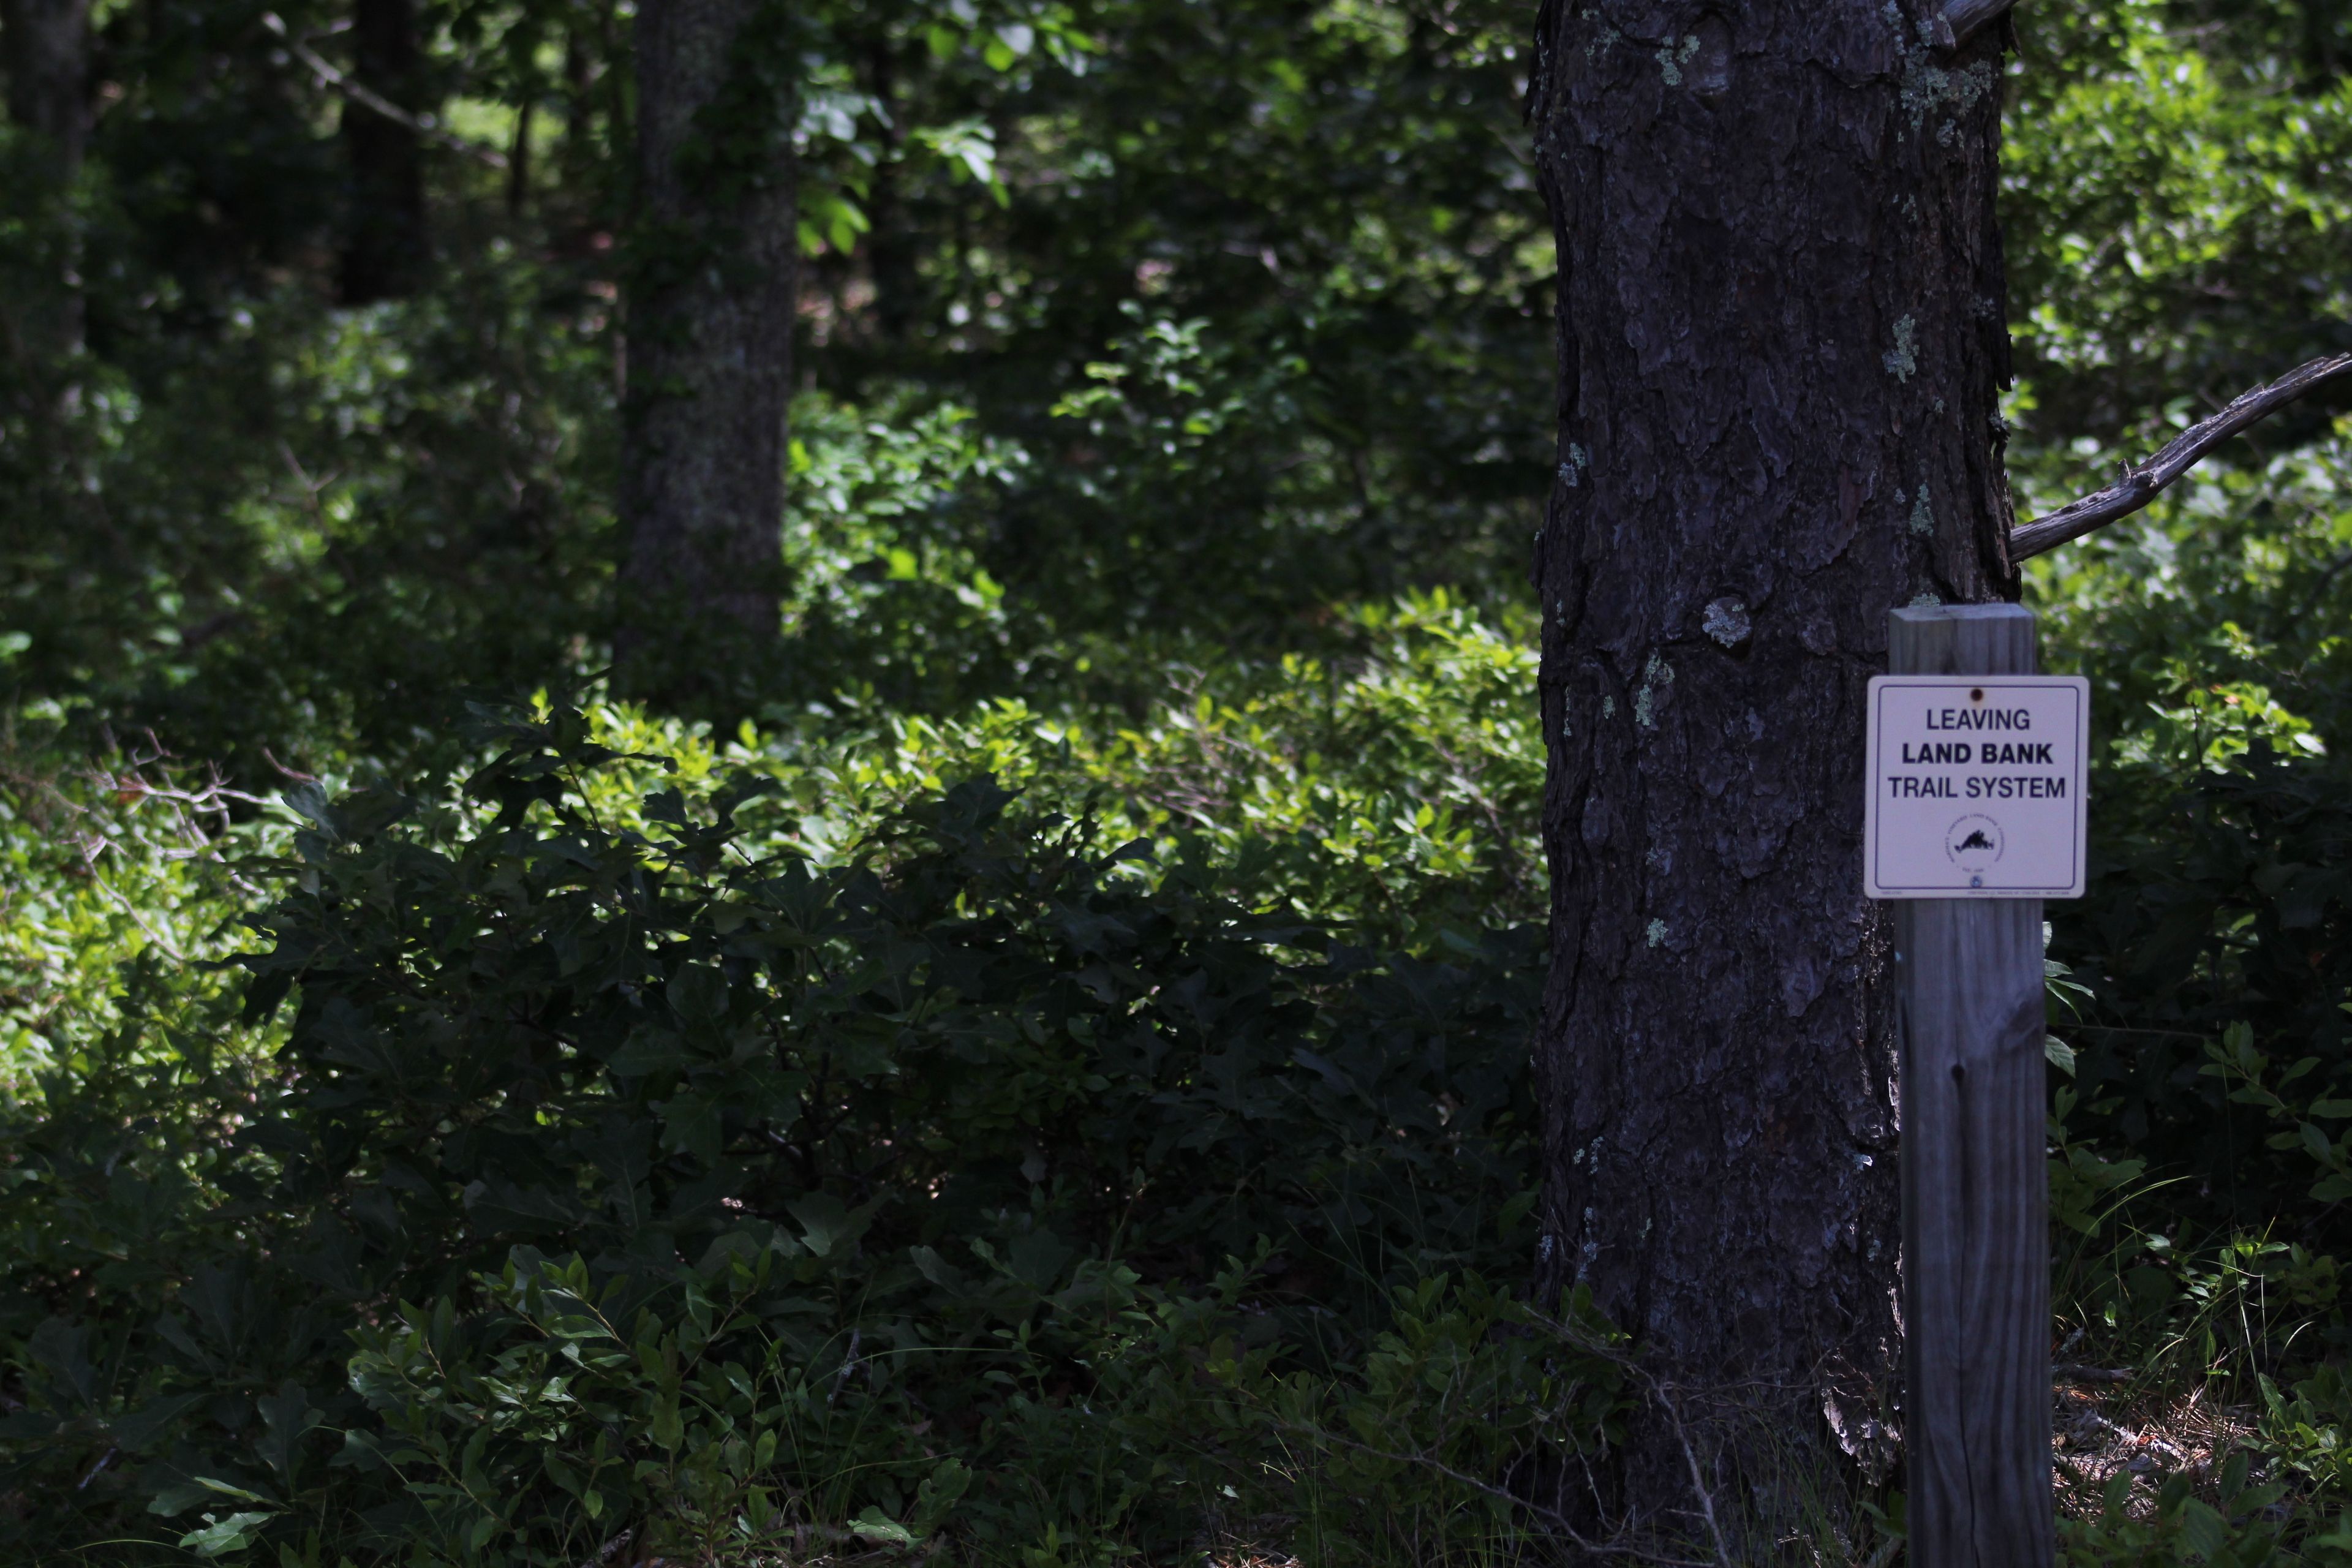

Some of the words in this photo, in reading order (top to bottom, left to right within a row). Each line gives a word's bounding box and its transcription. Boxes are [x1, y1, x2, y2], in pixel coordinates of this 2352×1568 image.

[1926, 709, 2030, 731] LEAVING
[1902, 742, 1972, 764] LAND
[1980, 743, 2054, 764] BANK
[1887, 777, 1958, 798] TRAIL
[1966, 777, 2065, 799] SYSTEM
